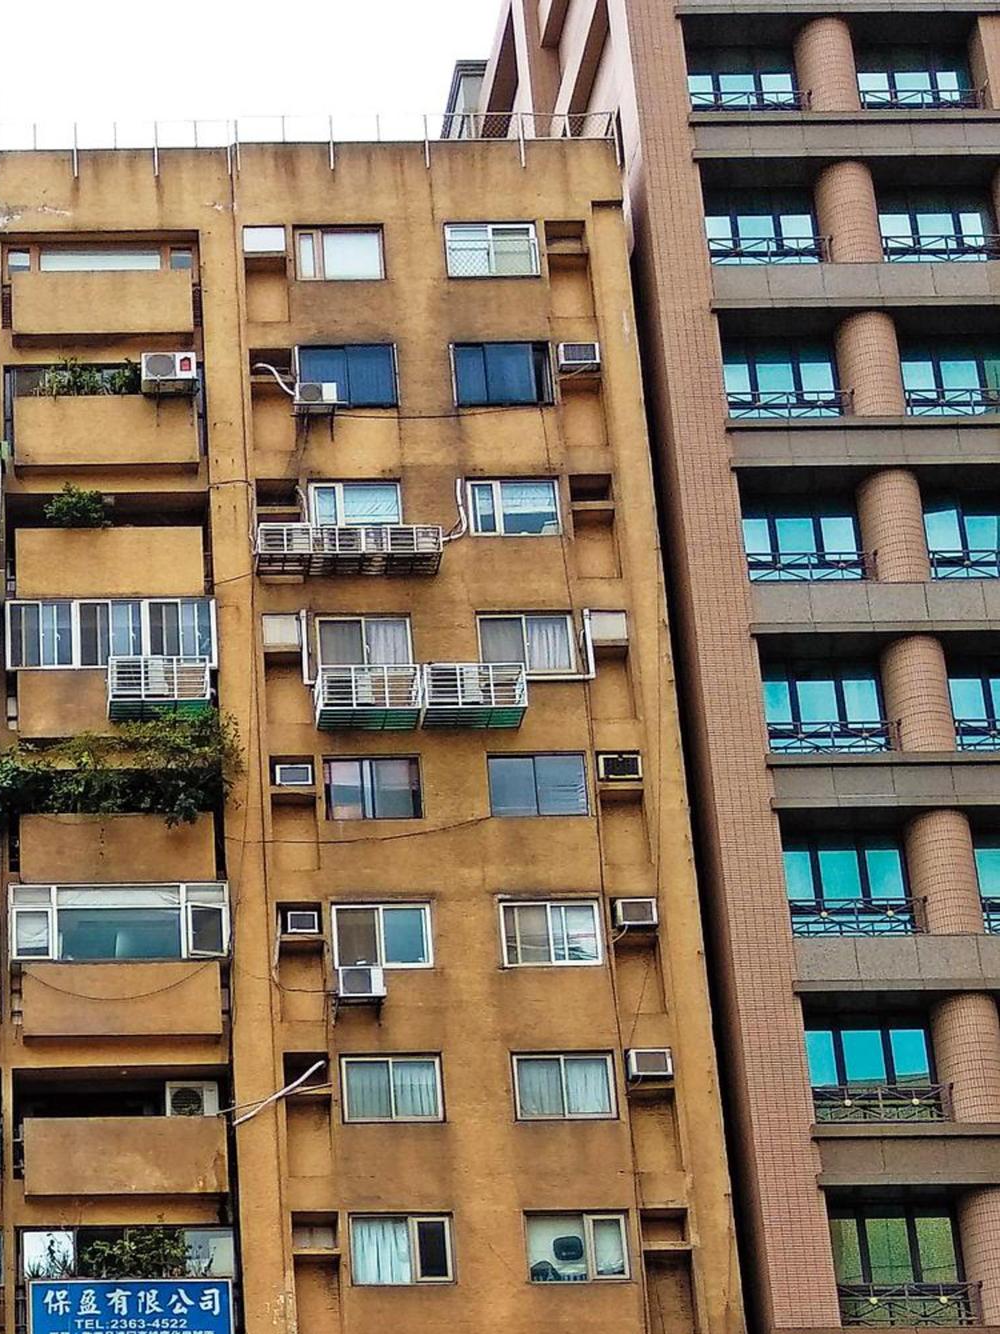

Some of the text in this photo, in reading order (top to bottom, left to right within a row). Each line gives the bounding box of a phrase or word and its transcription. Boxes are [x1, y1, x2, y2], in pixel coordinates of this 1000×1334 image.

[43, 1288, 221, 1316] 保盈有限公司
[74, 1319, 188, 1329] TEL:2363-4522
